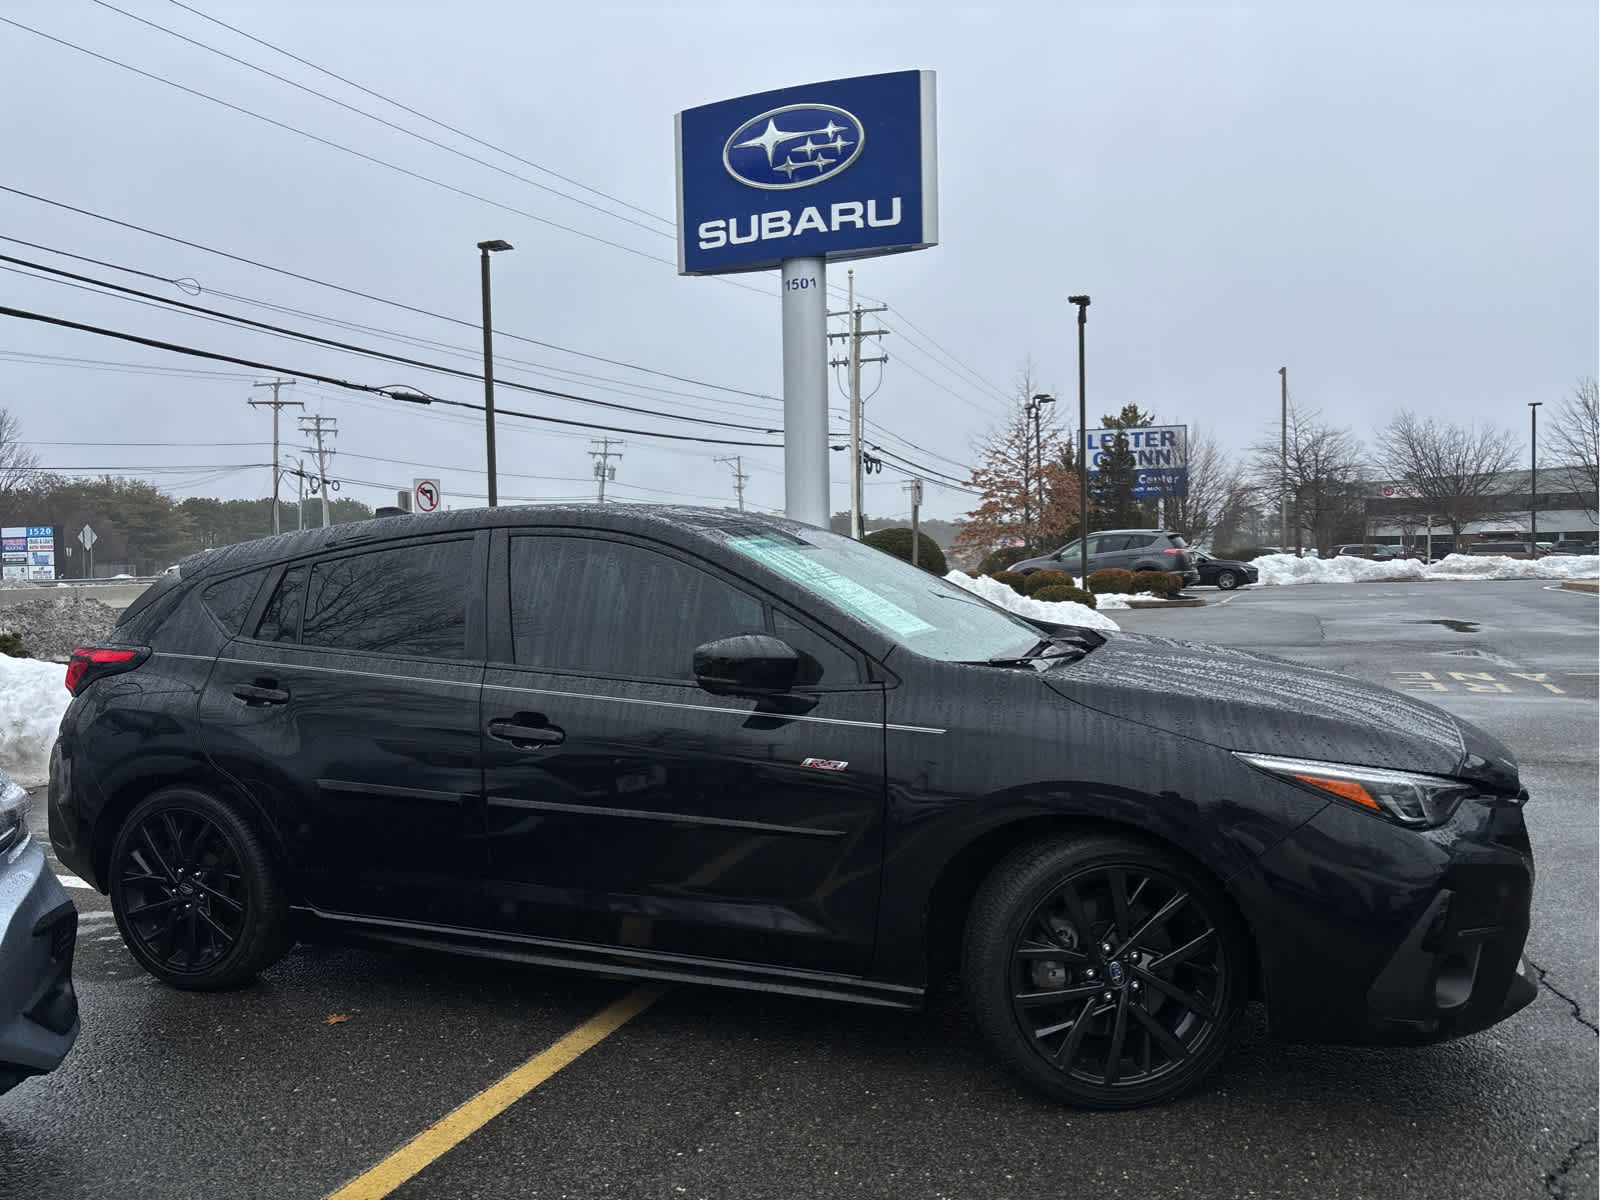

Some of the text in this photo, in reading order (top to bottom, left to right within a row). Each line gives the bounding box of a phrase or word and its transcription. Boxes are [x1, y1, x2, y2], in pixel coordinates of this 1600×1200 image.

[698, 196, 902, 250] SUBARU
[785, 277, 817, 292] 1501
[1087, 431, 1176, 450] LESTER
[1092, 449, 1171, 467] GNN
[29, 528, 51, 536] 1520
[1399, 681, 1567, 694] IRE
